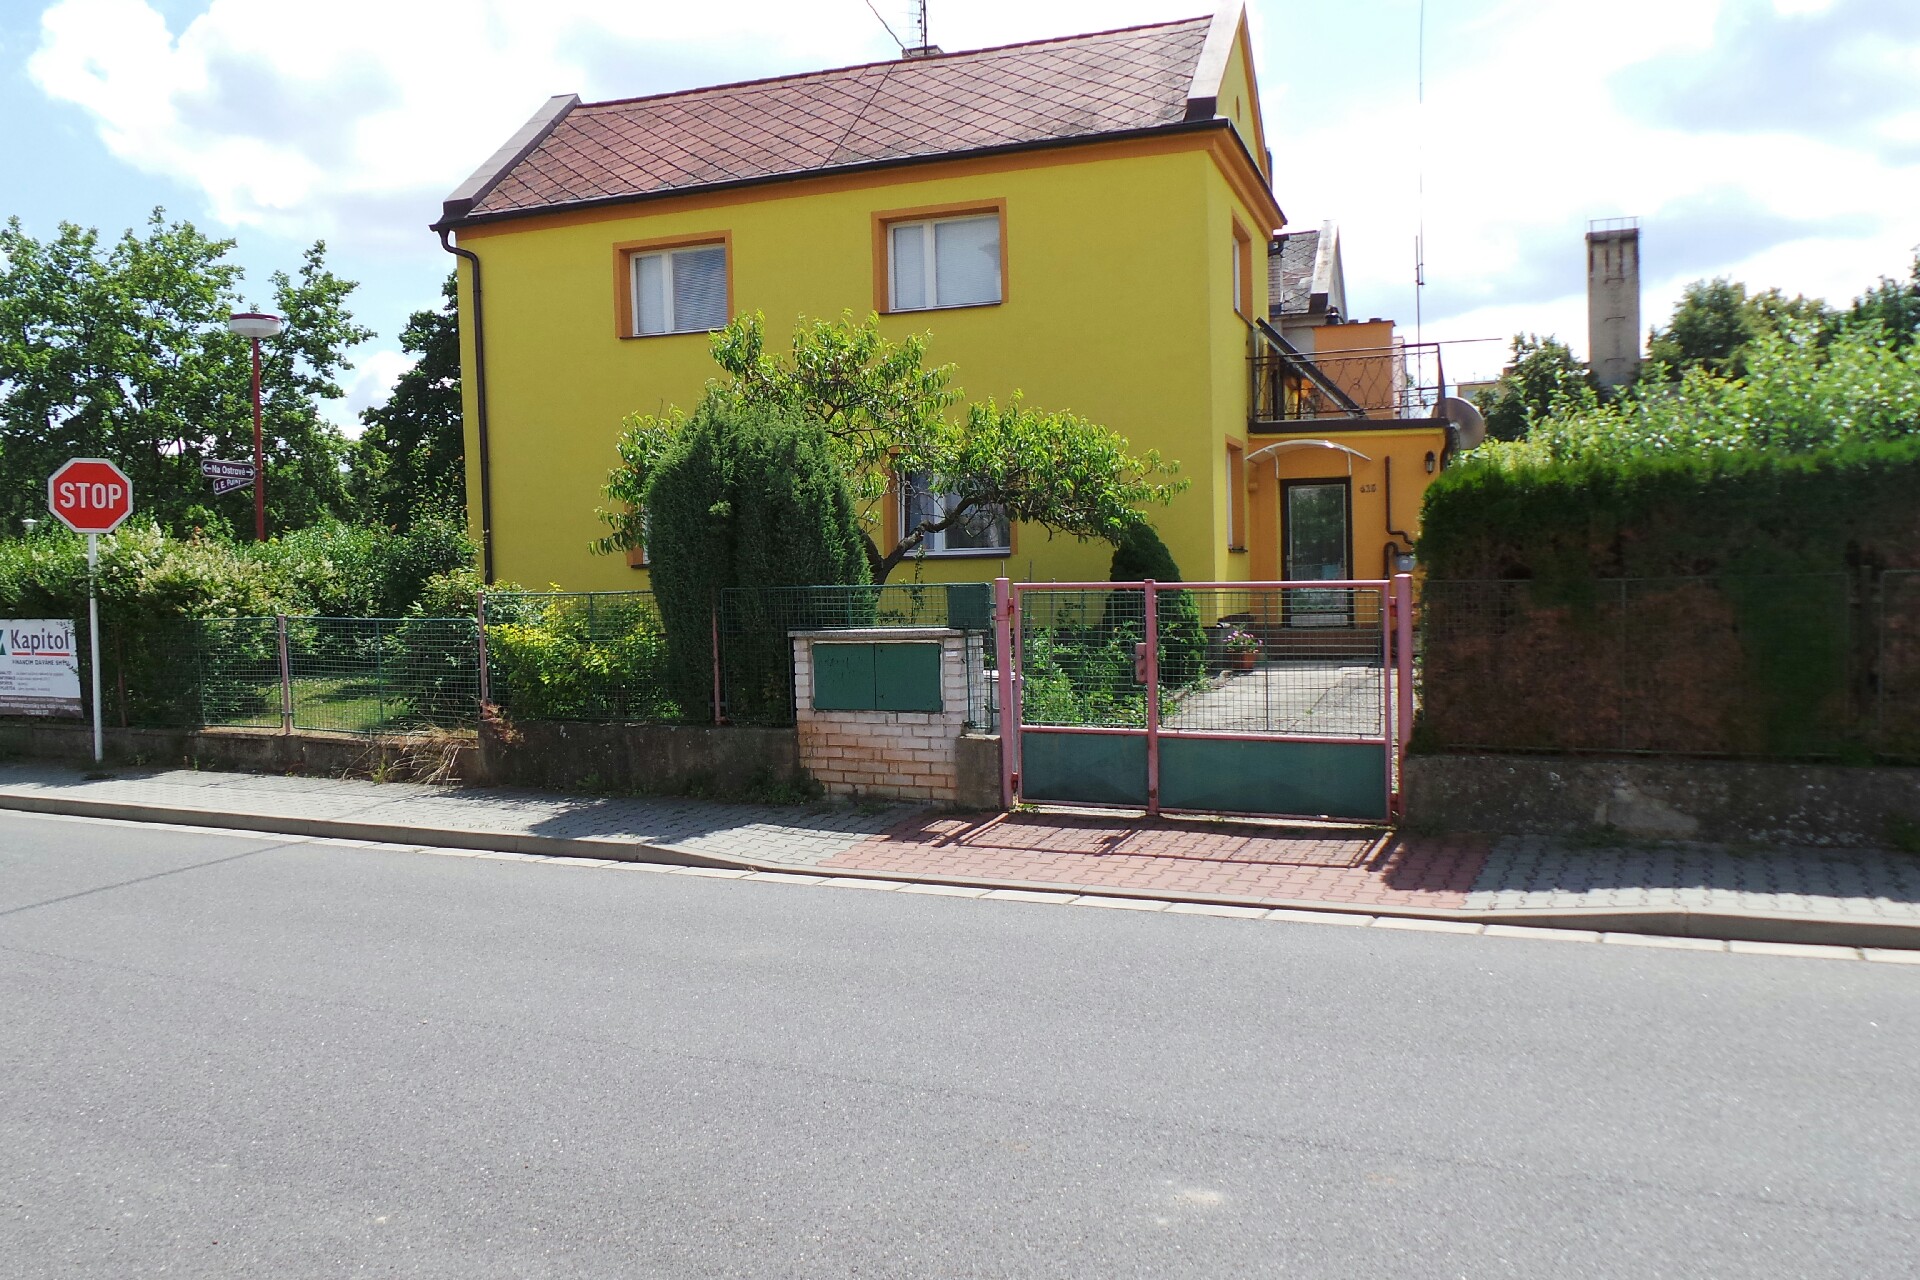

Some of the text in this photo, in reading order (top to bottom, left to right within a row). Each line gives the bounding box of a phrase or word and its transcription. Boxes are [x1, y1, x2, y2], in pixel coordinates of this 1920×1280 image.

[211, 464, 220, 474] Na
[60, 482, 122, 509] STOP
[10, 628, 70, 655] Kapitol
